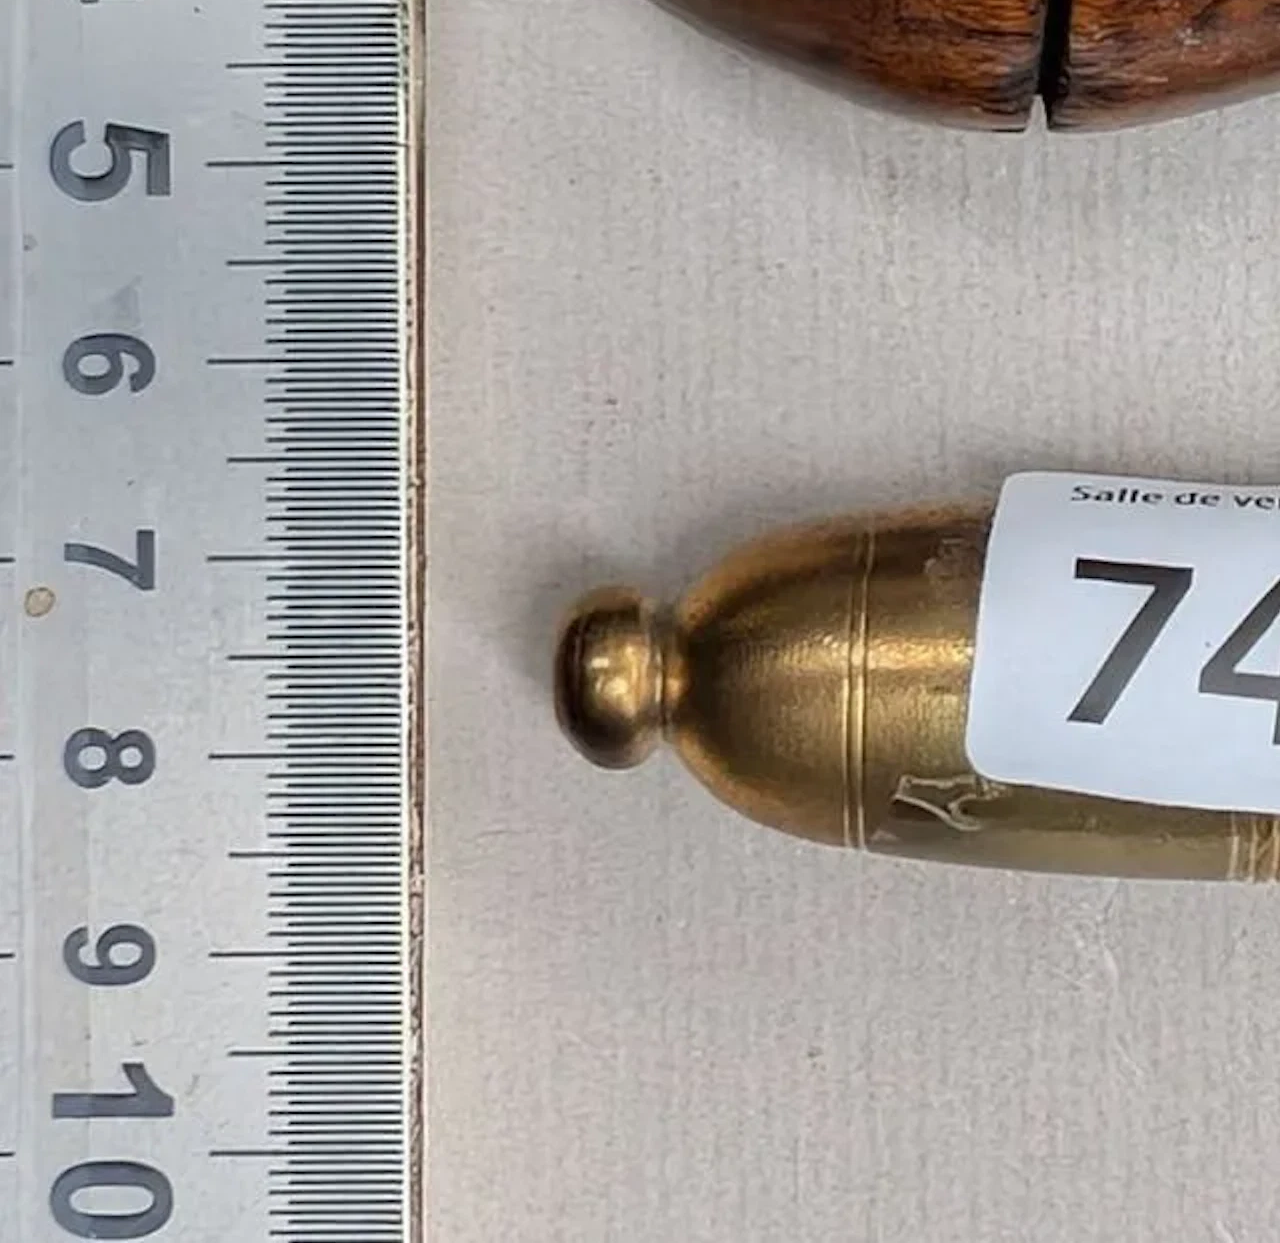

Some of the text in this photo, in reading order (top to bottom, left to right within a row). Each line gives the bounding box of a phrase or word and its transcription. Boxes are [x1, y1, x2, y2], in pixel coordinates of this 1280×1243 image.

[49, 120, 171, 202] 5
[61, 333, 156, 395] 6
[1071, 484, 1164, 506] Salle
[1174, 488, 1221, 509] de
[64, 529, 155, 590] 7
[63, 727, 157, 789] 8
[62, 924, 157, 987] 9
[50, 1062, 175, 1241] 10
